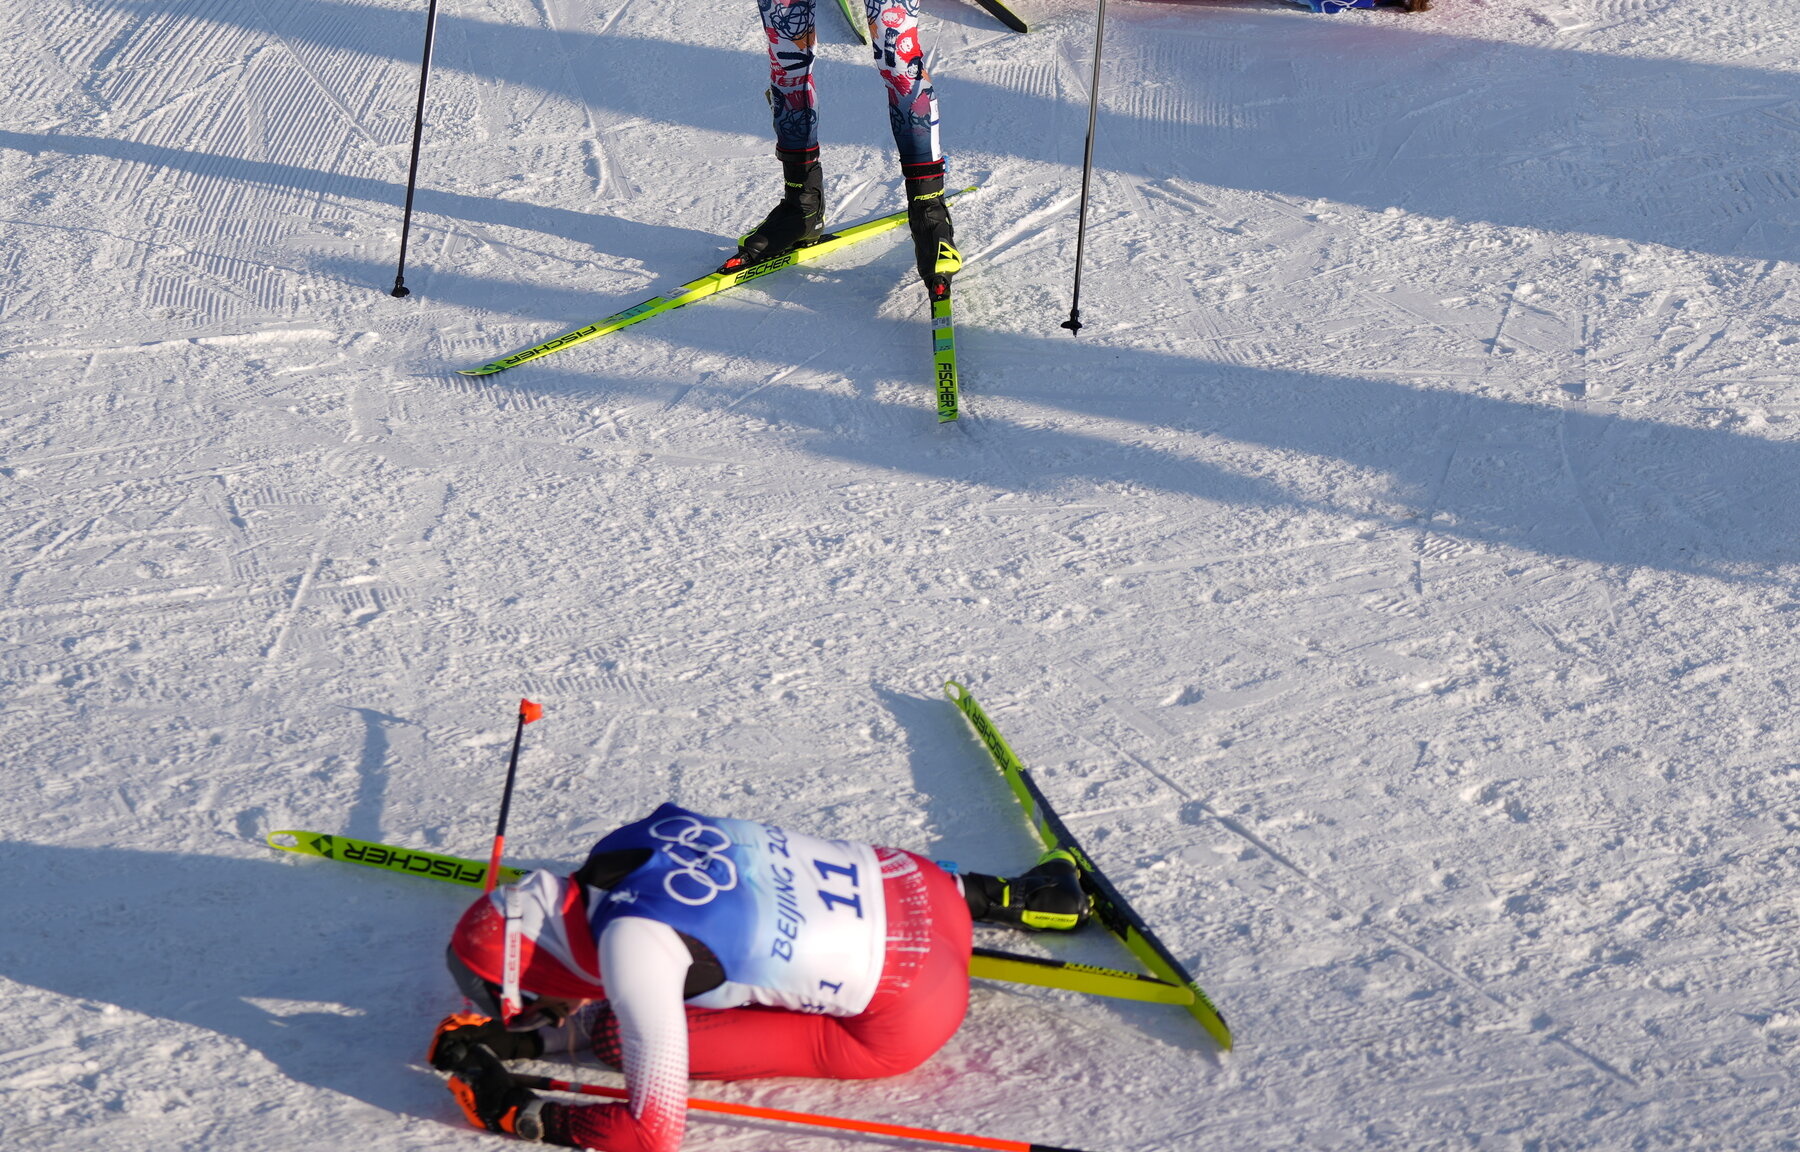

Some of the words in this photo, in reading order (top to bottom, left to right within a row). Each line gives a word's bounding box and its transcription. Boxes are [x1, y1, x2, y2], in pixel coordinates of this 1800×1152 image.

[734, 255, 791, 284] FISCHER
[503, 325, 597, 365] FISCHER
[937, 362, 955, 408] FISCHER
[972, 706, 1010, 772] FISCHER
[343, 842, 486, 884] FISCHER
[813, 858, 864, 920] 11
[770, 863, 807, 963] BEIJING
